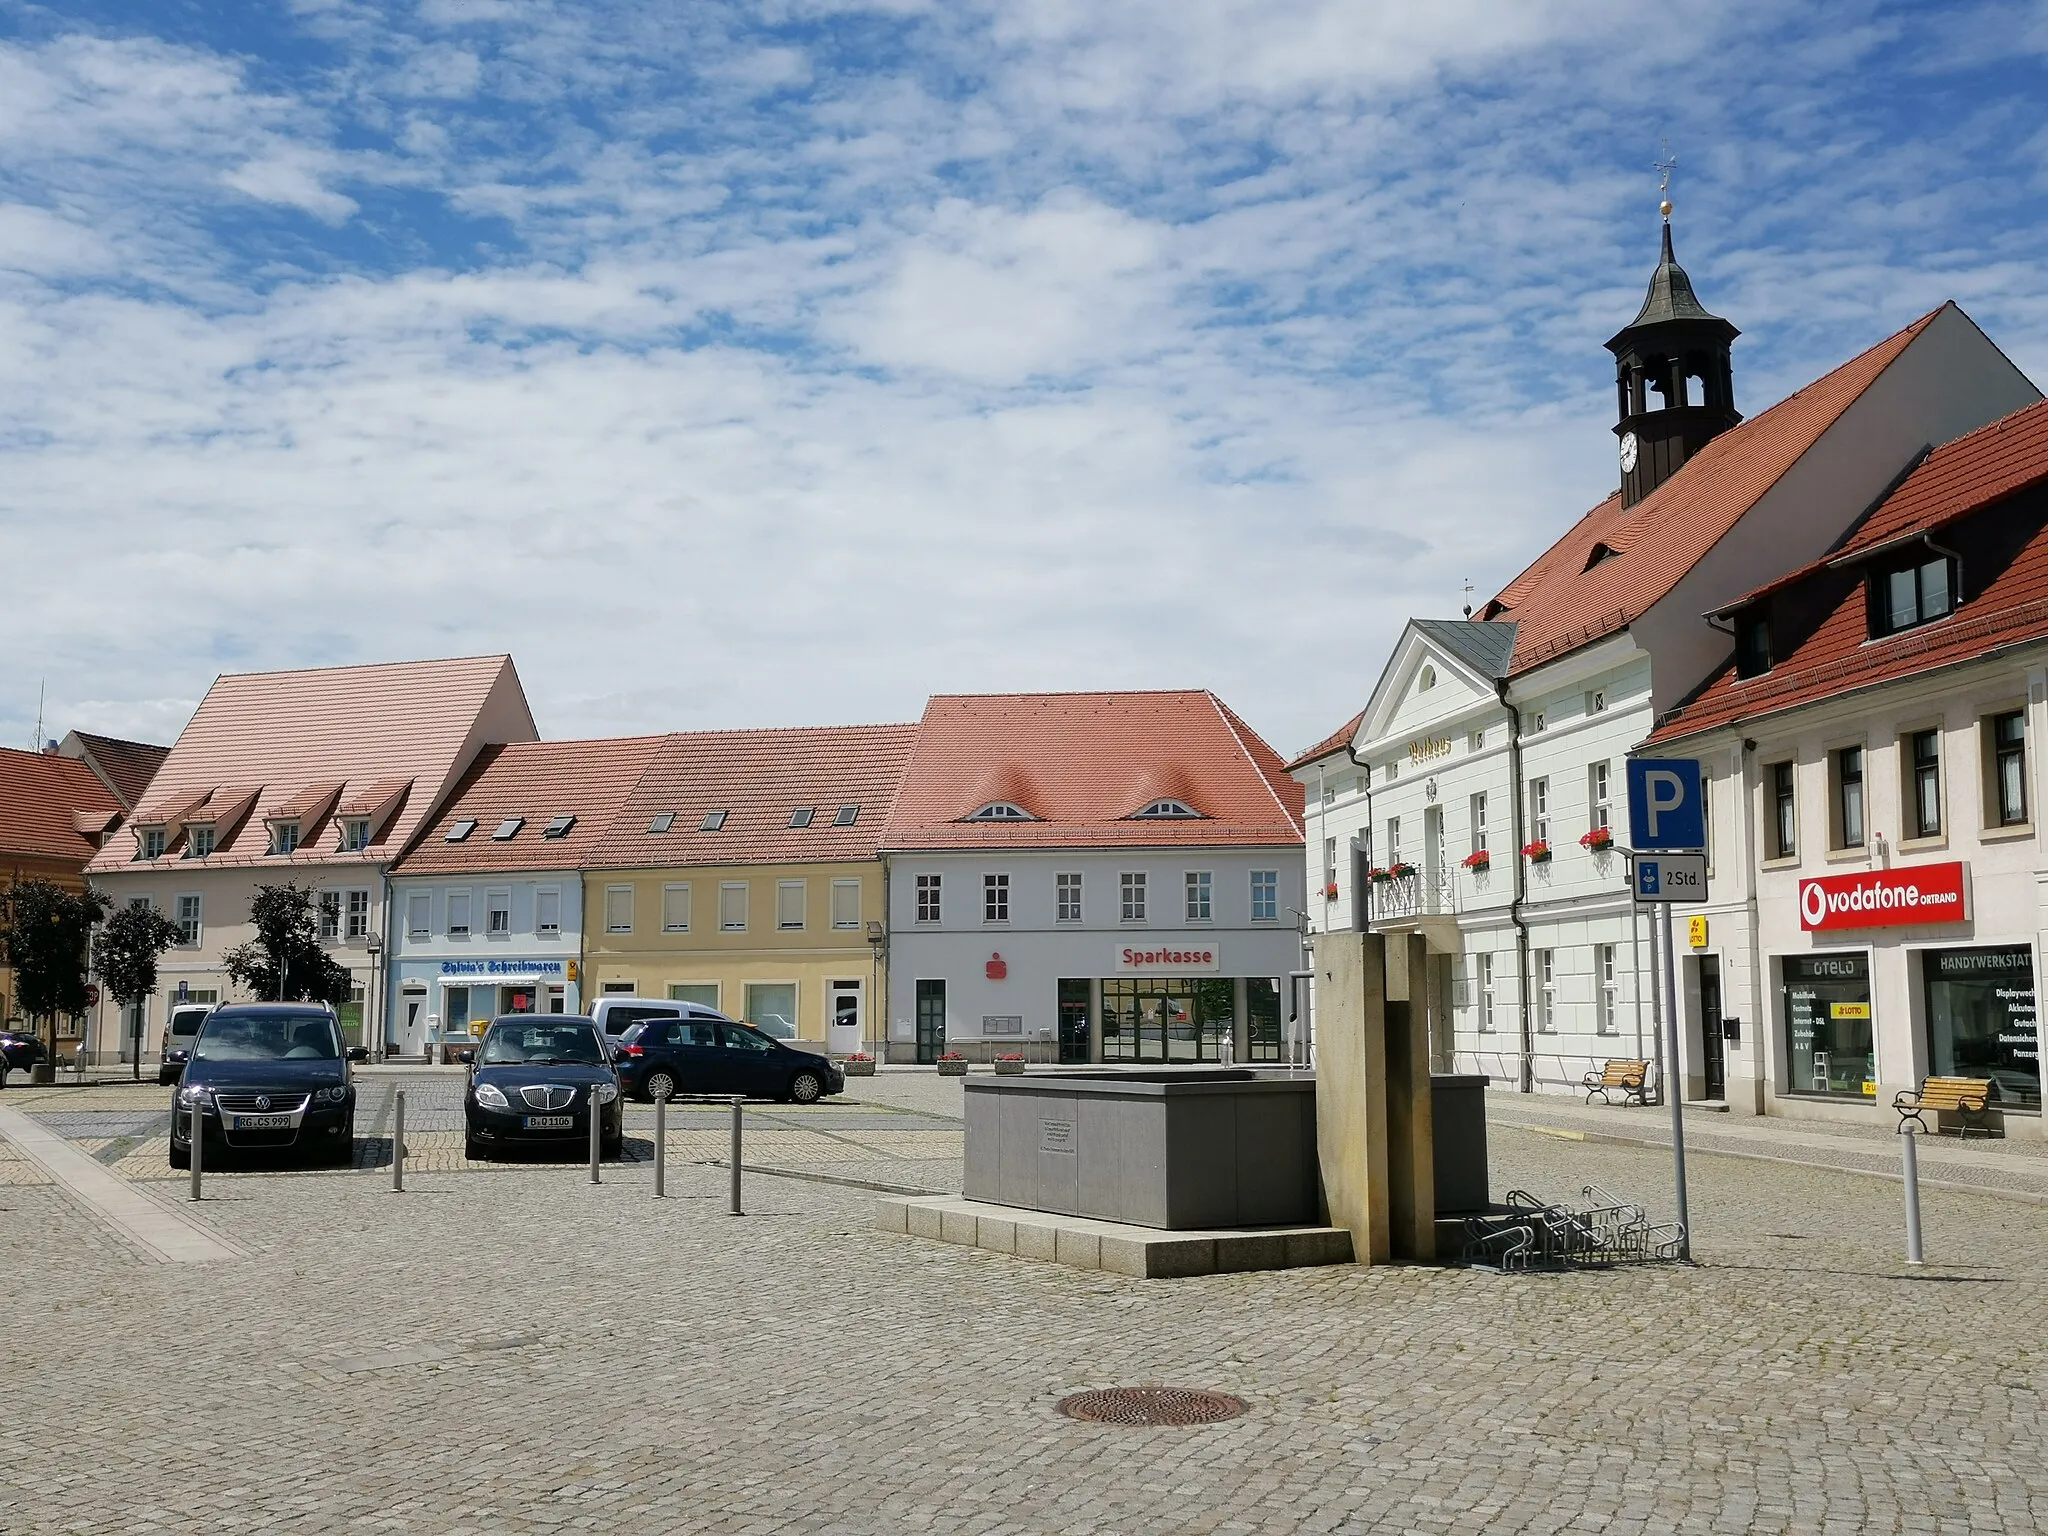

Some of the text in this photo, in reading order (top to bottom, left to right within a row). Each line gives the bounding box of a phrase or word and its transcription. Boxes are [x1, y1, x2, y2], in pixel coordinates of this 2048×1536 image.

[1409, 736, 1451, 767] Rathaus
[1645, 770, 1685, 837] P
[1666, 871, 1700, 886] 2 Std.
[1827, 880, 1957, 912] vodafone ORTRAND
[1122, 948, 1212, 967] Sparkasse
[1940, 954, 2033, 970] HANDYWERKSTAT
[441, 960, 561, 975] Sylvia's Schreibwaren
[1845, 1006, 1862, 1015] LOTTO
[1793, 1017, 1812, 1025] Internet
[272, 1117, 289, 1126] 999
